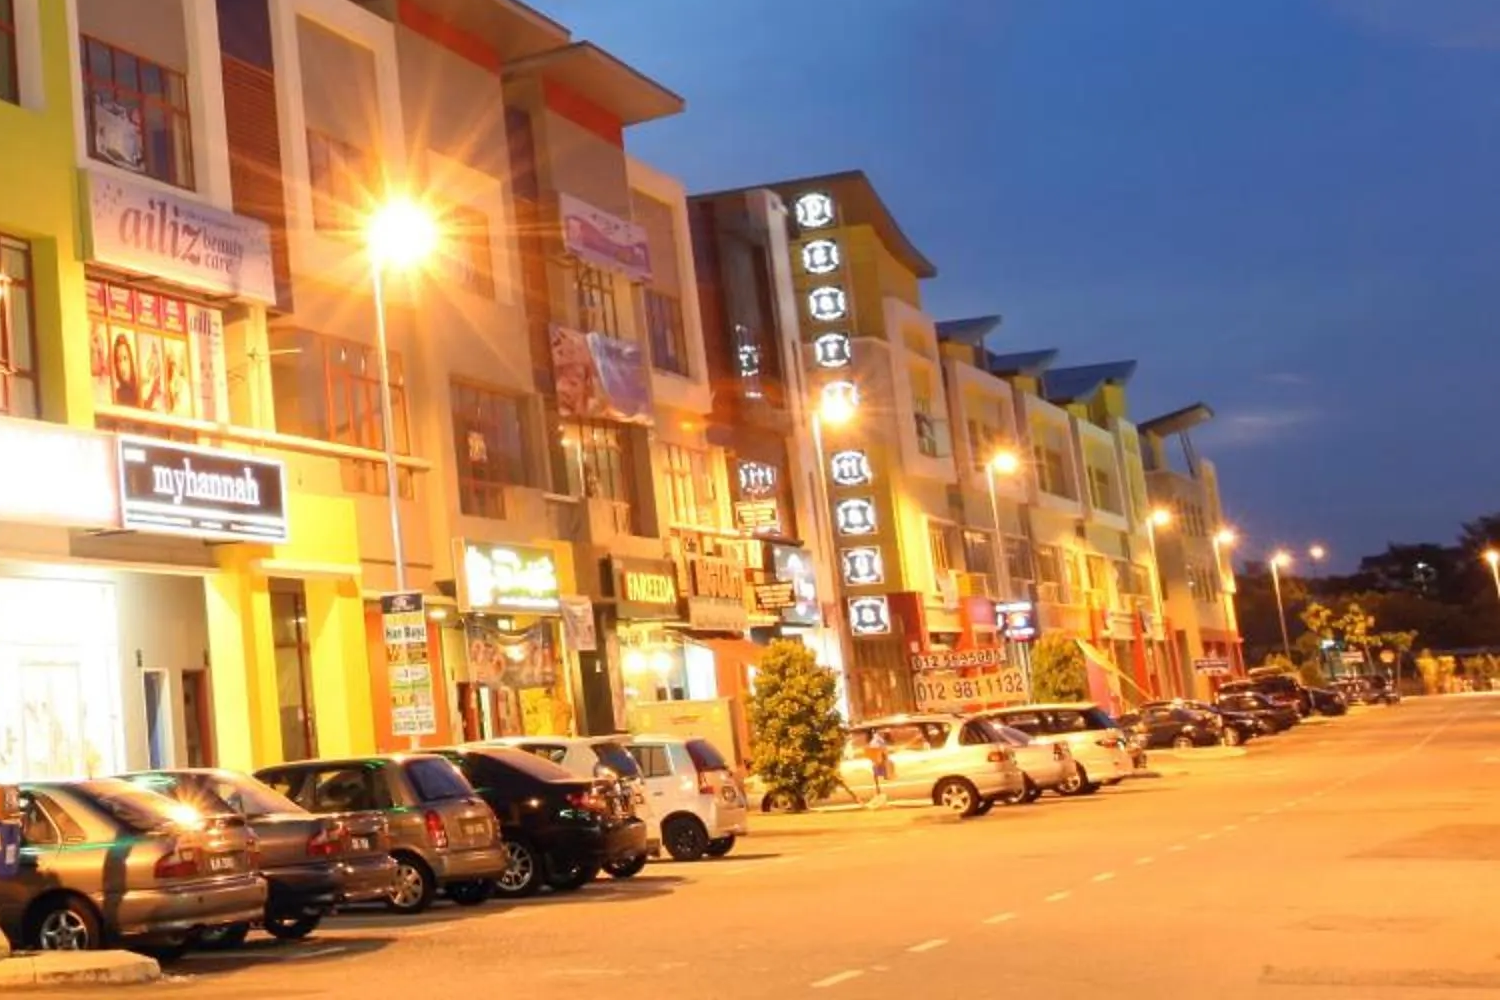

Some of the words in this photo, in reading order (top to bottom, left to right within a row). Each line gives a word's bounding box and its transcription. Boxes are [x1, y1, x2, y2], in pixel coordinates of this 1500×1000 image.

[119, 199, 201, 267] ailiz
[205, 253, 235, 275] care
[151, 457, 261, 507] myhannah
[915, 681, 946, 701] 012
